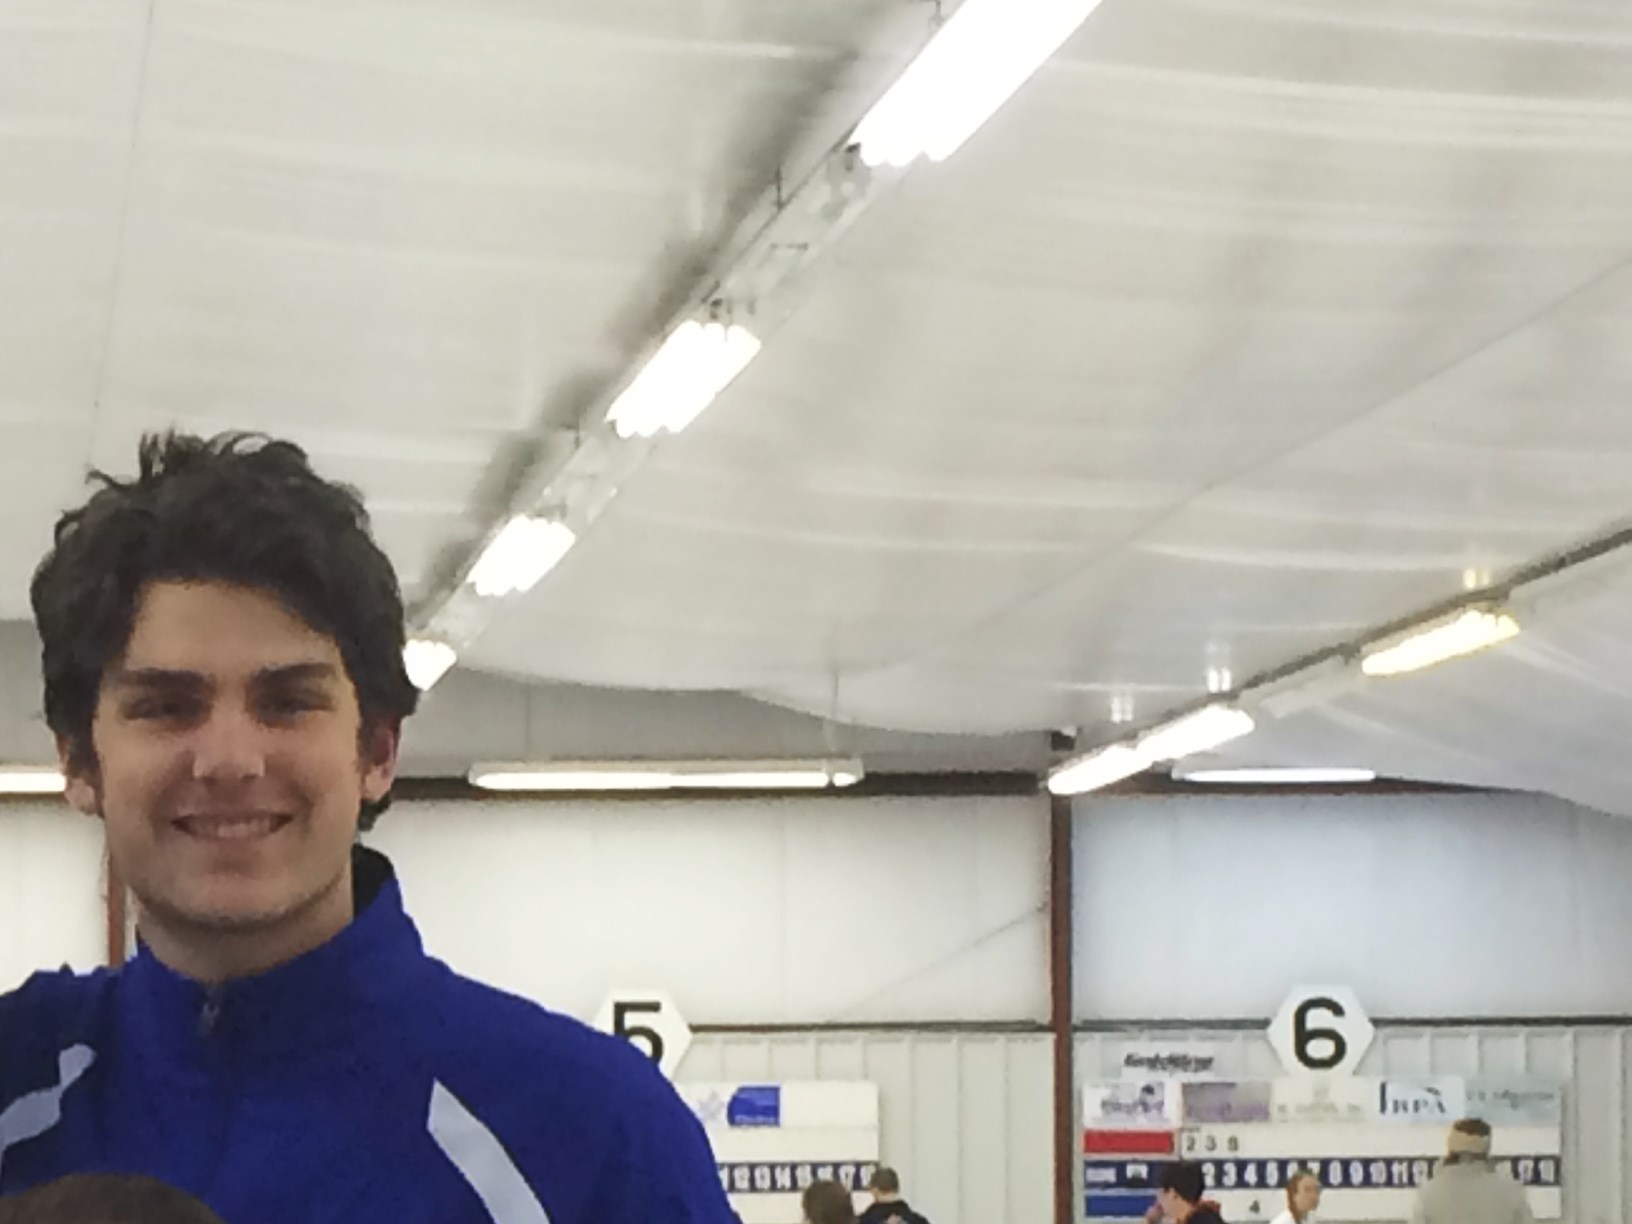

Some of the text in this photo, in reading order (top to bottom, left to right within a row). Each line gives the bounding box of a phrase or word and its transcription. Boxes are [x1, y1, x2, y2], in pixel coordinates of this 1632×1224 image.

[614, 1001, 662, 1064] 5
[1294, 997, 1347, 1069] 6
[1223, 1162, 1237, 1187] 3
[1244, 1162, 1258, 1187] 4
[1266, 1162, 1279, 1187] 5
